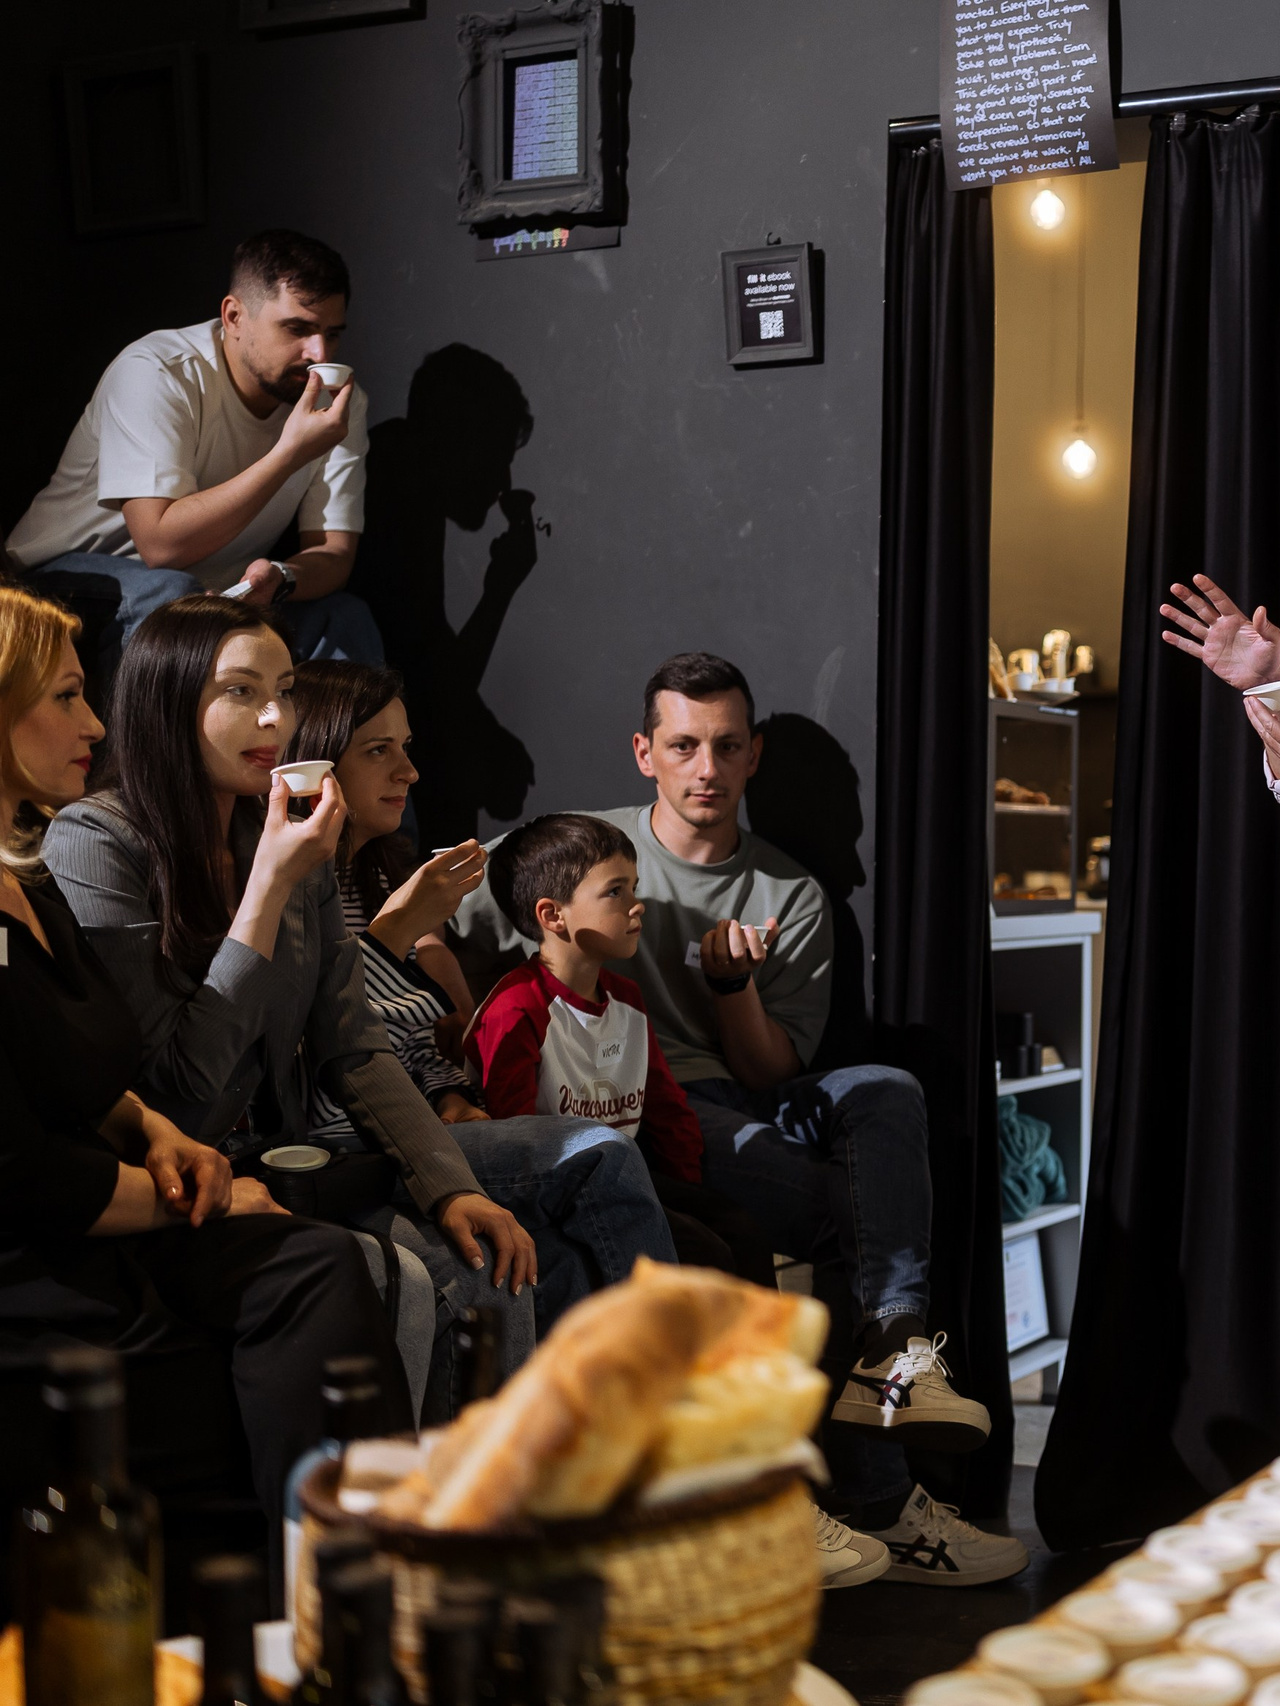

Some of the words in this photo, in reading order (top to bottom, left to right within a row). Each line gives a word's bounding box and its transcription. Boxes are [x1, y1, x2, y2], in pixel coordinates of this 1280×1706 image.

[955, 26, 973, 37] you
[974, 21, 987, 30] to
[1060, 4, 1090, 13] them
[956, 7, 998, 21] enacted.
[956, 36, 983, 47] what
[983, 32, 1004, 44] they
[1008, 24, 1043, 39] expect.
[1046, 19, 1072, 34] Truly
[957, 48, 983, 61] prove
[986, 43, 1004, 53] the
[988, 55, 1008, 66] real
[1012, 48, 1061, 67] problems.
[1063, 43, 1091, 54] Earn
[955, 73, 987, 85] trust,
[991, 66, 1038, 81] leverage,
[955, 88, 977, 99] This
[980, 83, 1012, 97] effort
[1015, 82, 1024, 91] is
[1027, 78, 1040, 89] all
[1041, 74, 1067, 92] part
[1071, 70, 1085, 82] of
[953, 103, 972, 112] the
[975, 97, 1006, 115] grand
[1010, 92, 1046, 107] design,
[1017, 108, 1037, 122] only
[1080, 96, 1090, 109] &
[1041, 116, 1064, 127] that
[958, 157, 975, 167] we
[979, 153, 1019, 165] continue
[1021, 150, 1038, 159] the
[1076, 141, 1089, 152] All
[989, 169, 1007, 183] you
[1010, 165, 1023, 174] to
[767, 271, 791, 281] ebook
[744, 284, 777, 295] available
[778, 283, 795, 291] now
[559, 1084, 643, 1118] Vancouver
